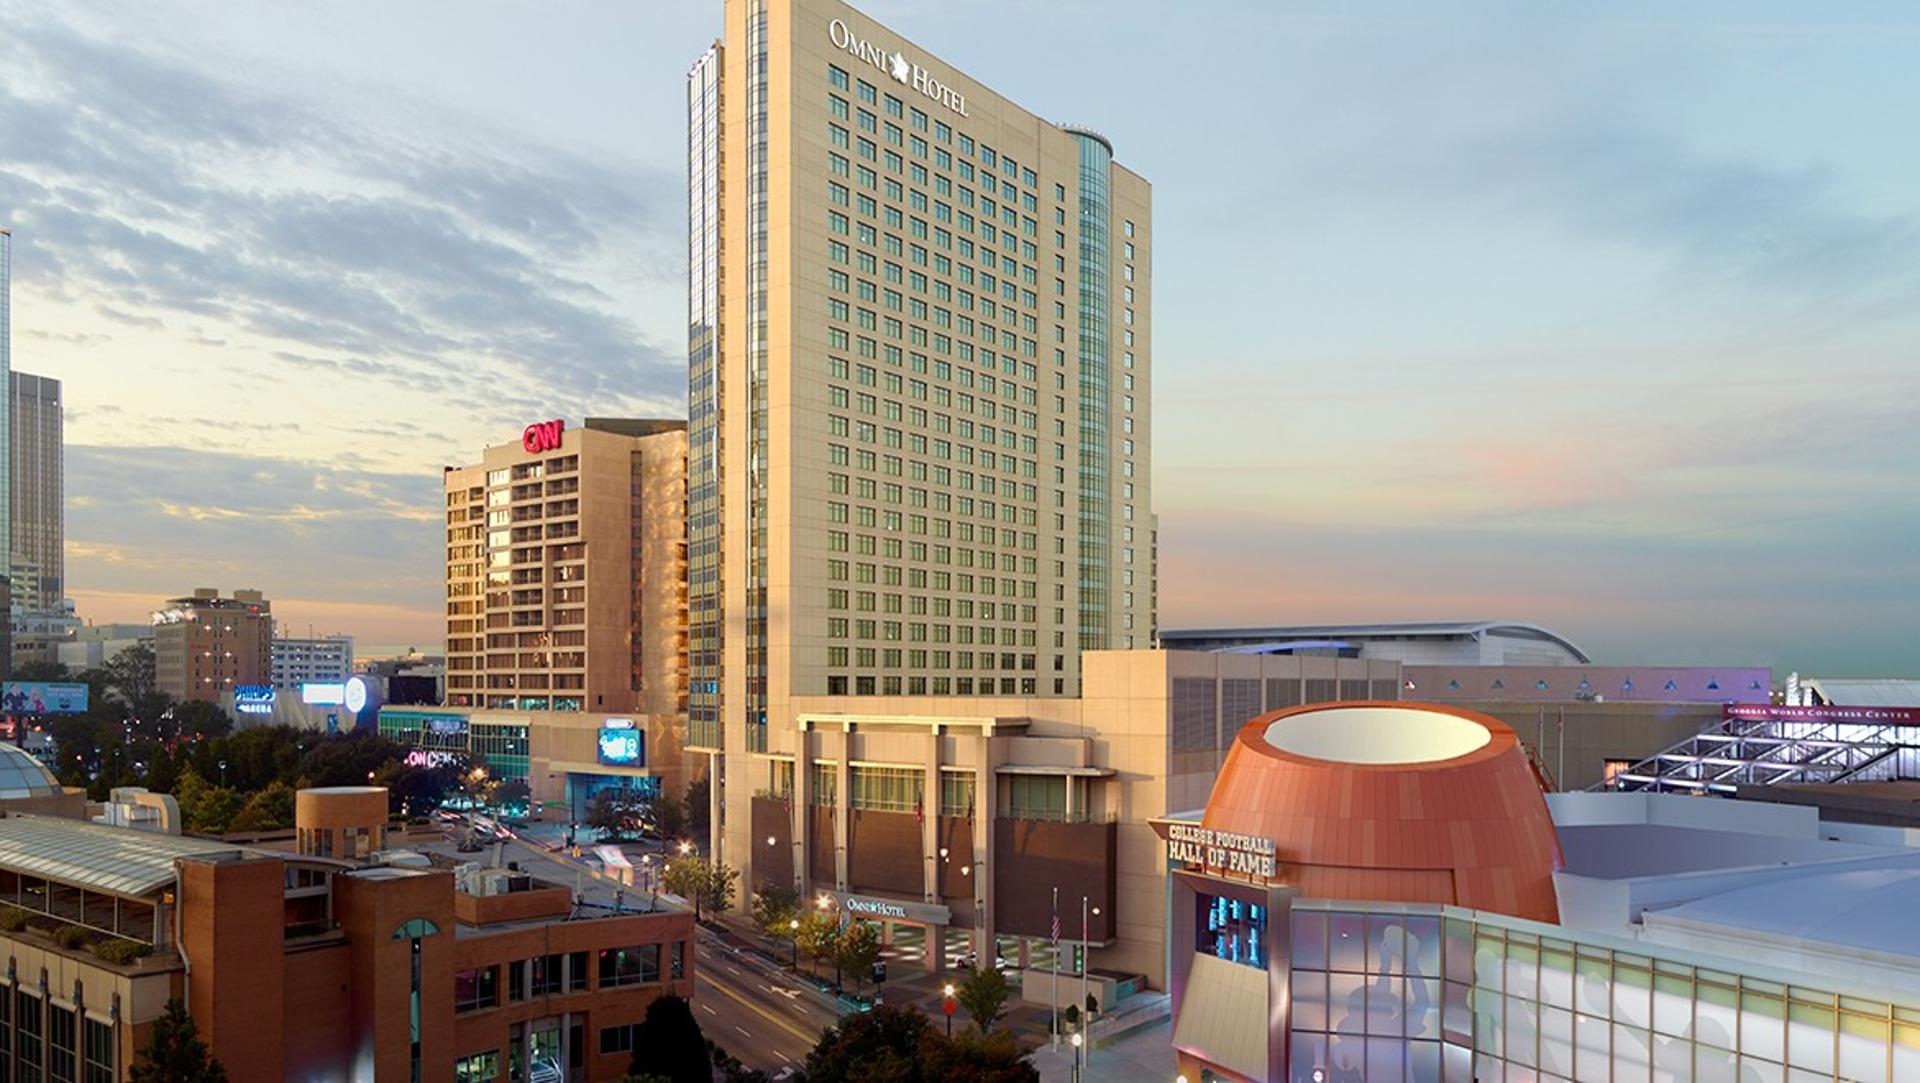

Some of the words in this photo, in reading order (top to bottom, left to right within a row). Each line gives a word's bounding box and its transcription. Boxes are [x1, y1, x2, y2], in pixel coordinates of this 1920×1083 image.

[523, 419, 564, 453] CNN
[235, 685, 275, 700] PHILIPS
[1169, 825, 1213, 844] COLLEGE
[1215, 831, 1272, 854] FOOTBALL
[1169, 840, 1203, 864] HALL
[1208, 847, 1225, 866] OF
[1229, 851, 1272, 876] FAME
